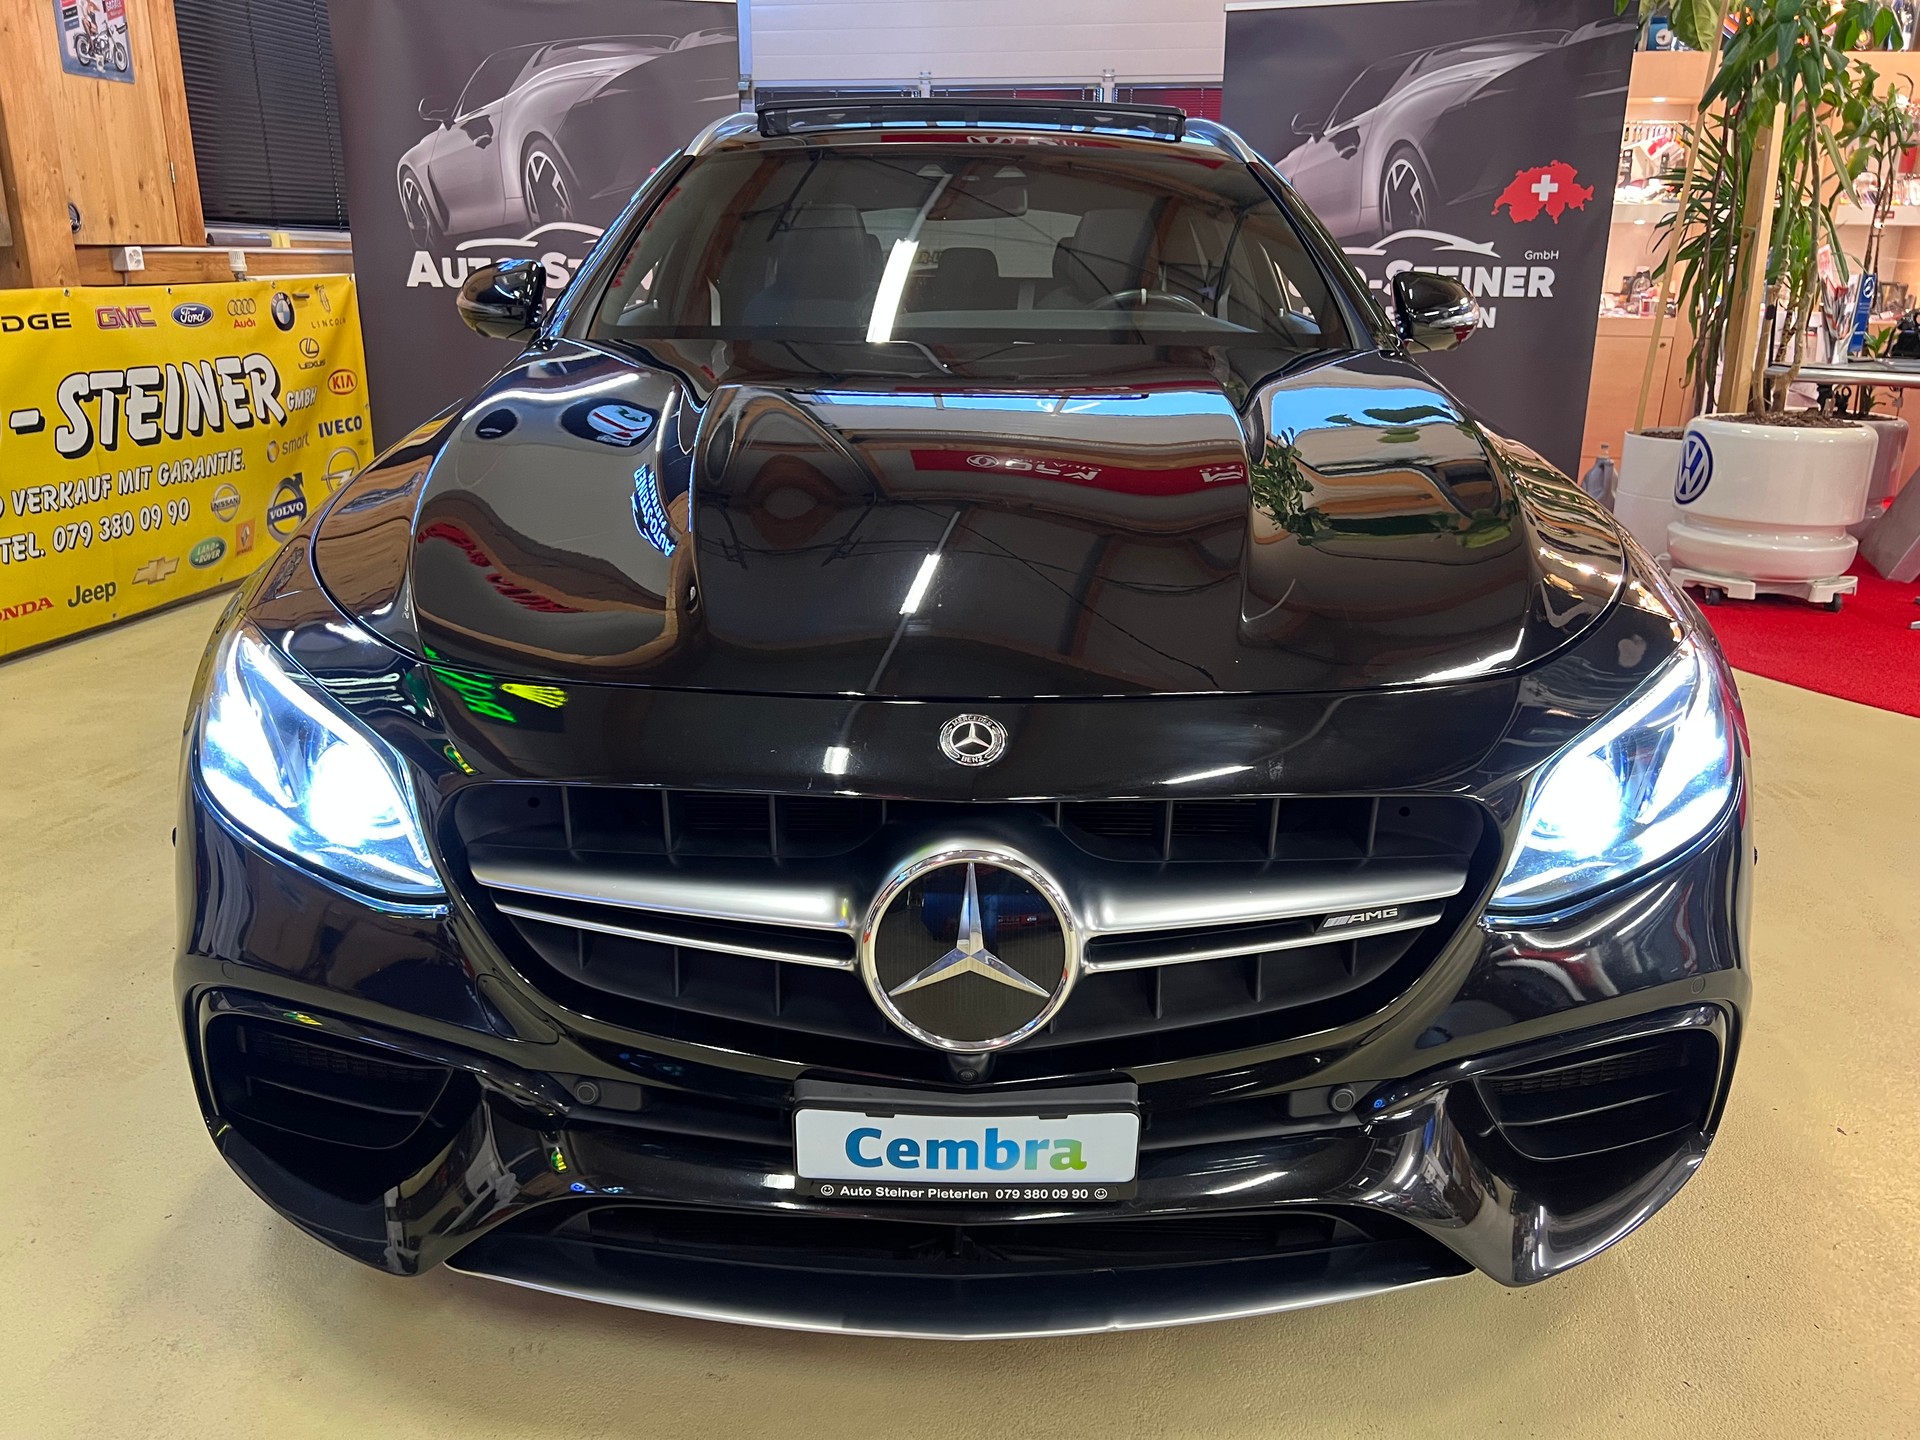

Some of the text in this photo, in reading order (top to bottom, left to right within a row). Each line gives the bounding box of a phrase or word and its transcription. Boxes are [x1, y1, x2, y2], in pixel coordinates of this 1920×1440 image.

[1524, 250, 1559, 260] GmbH
[95, 305, 157, 330] GMC
[179, 306, 206, 324] Ford
[233, 318, 256, 329] Audi
[332, 374, 355, 390] KIA
[286, 385, 318, 413] GMBH
[318, 415, 362, 438] IVECO
[282, 432, 311, 455] smart
[11, 473, 112, 517] VERKAUF
[118, 465, 152, 496] MIT
[157, 448, 245, 487] GARANTIE.
[213, 498, 239, 510] NISSAN
[269, 501, 304, 520] VOLVO
[0, 497, 190, 564] TEL. 079 380 09 90
[68, 581, 117, 608] Jeep
[1347, 907, 1398, 924] AMG
[844, 1127, 1088, 1172] Cembra
[839, 1186, 1088, 1200] Auto Steiner Pieterlen 079 380 09 90
